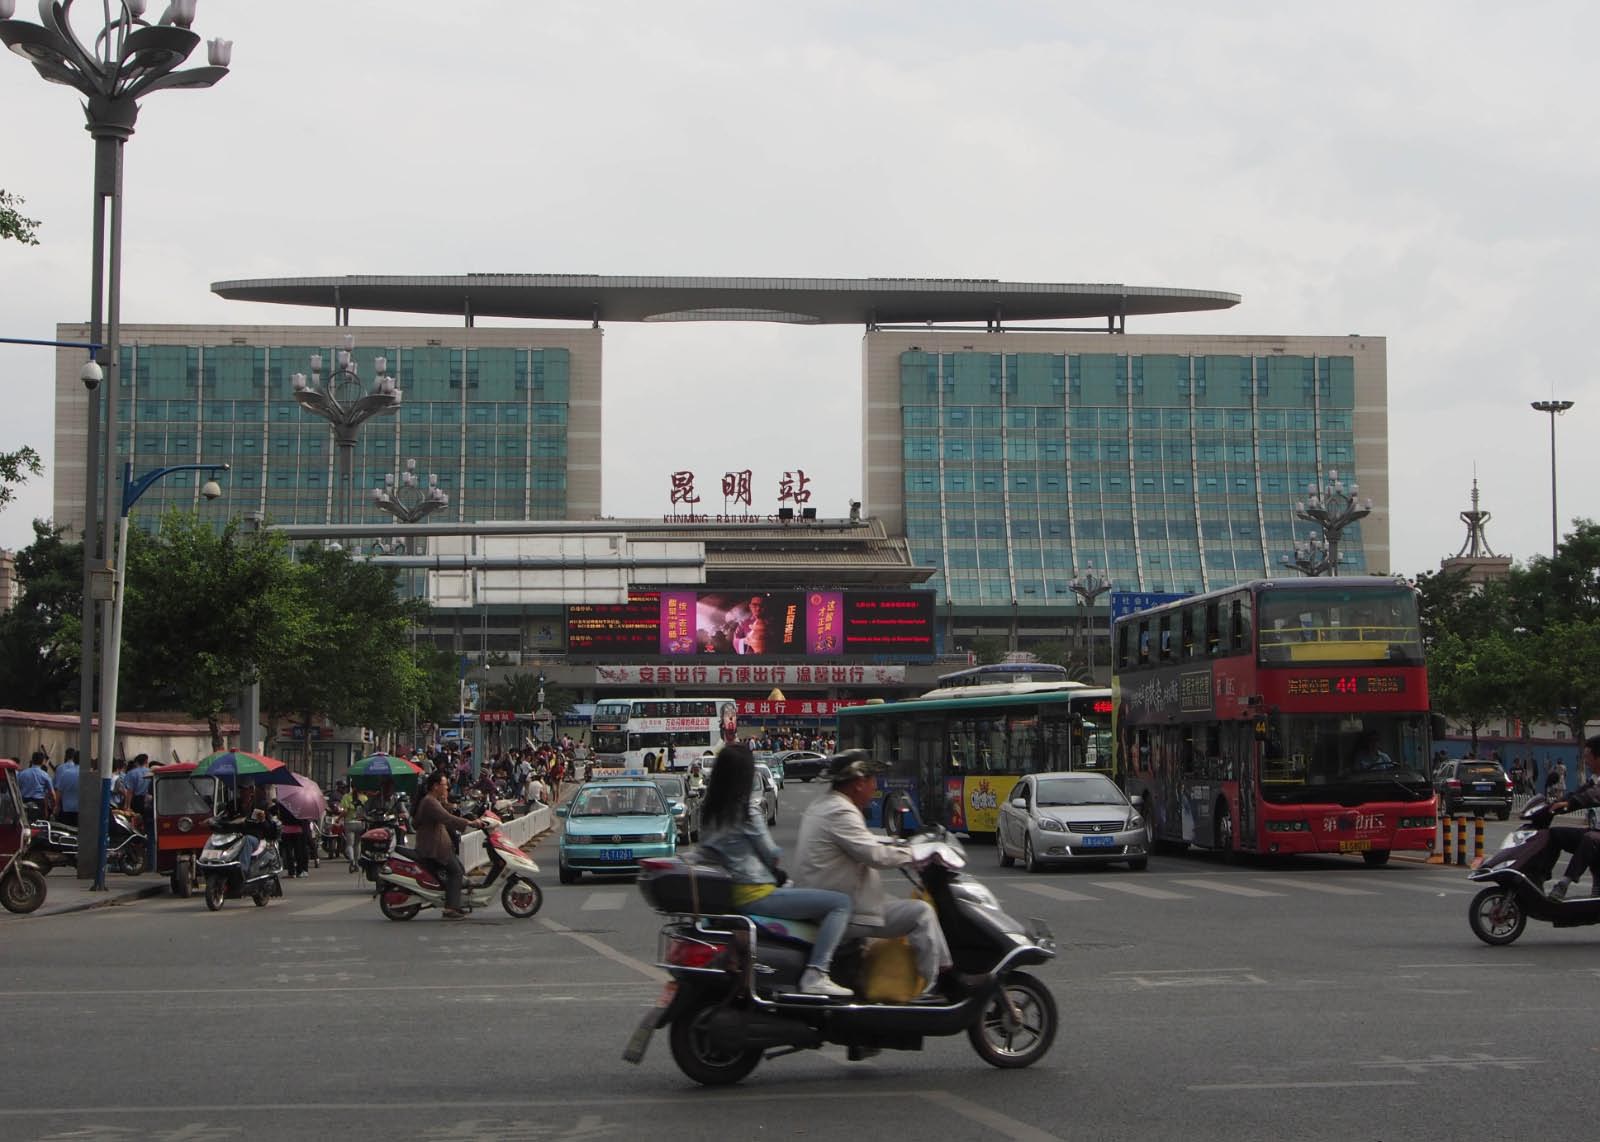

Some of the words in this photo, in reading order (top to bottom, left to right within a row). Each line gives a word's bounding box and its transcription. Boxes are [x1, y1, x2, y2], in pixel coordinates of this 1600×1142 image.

[671, 469, 811, 505] 昆明站
[664, 514, 708, 524] KUNMING
[716, 514, 760, 524] RAILWAY
[639, 667, 707, 683] 安全出行
[718, 667, 785, 683] 方便出行
[797, 667, 864, 683] 温馨出行
[1335, 676, 1357, 694] 44
